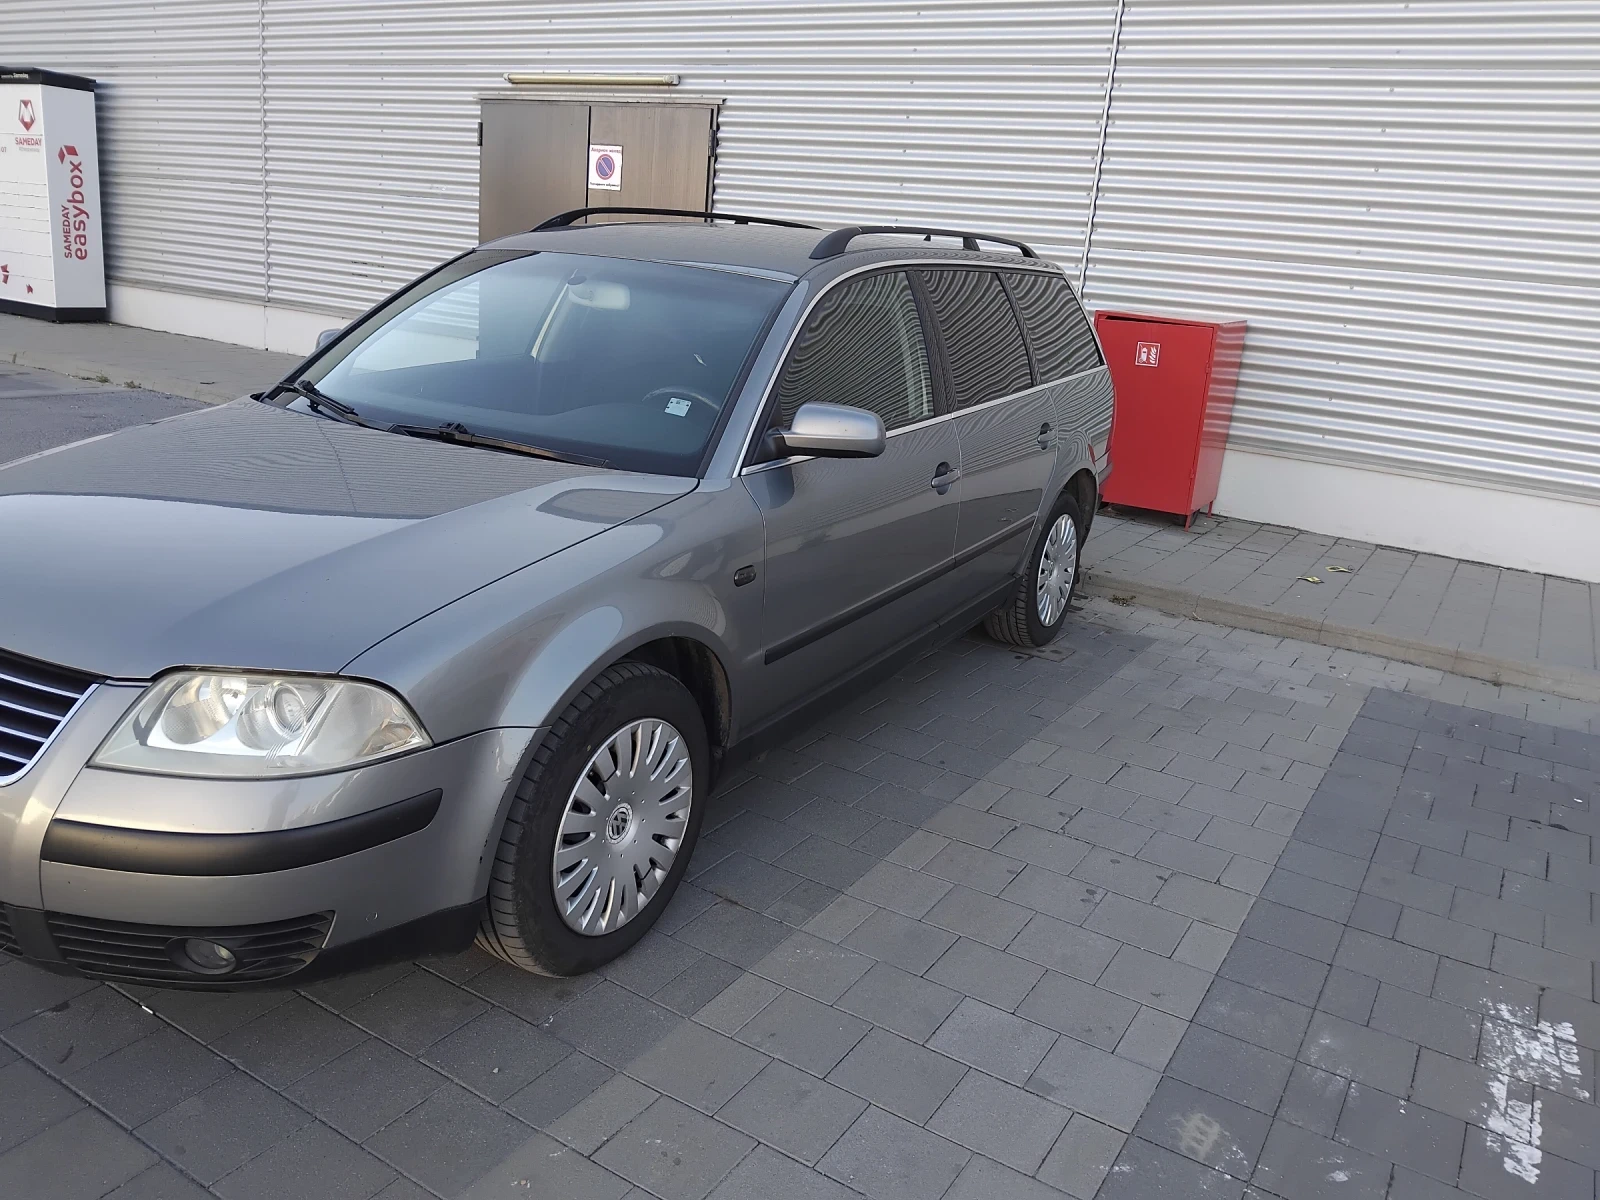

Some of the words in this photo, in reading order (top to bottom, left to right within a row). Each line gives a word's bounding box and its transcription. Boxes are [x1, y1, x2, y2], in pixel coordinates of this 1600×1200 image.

[15, 136, 42, 146] SAMEDAY
[61, 204, 73, 259] SAMEDAY
[67, 160, 90, 261] easybox
